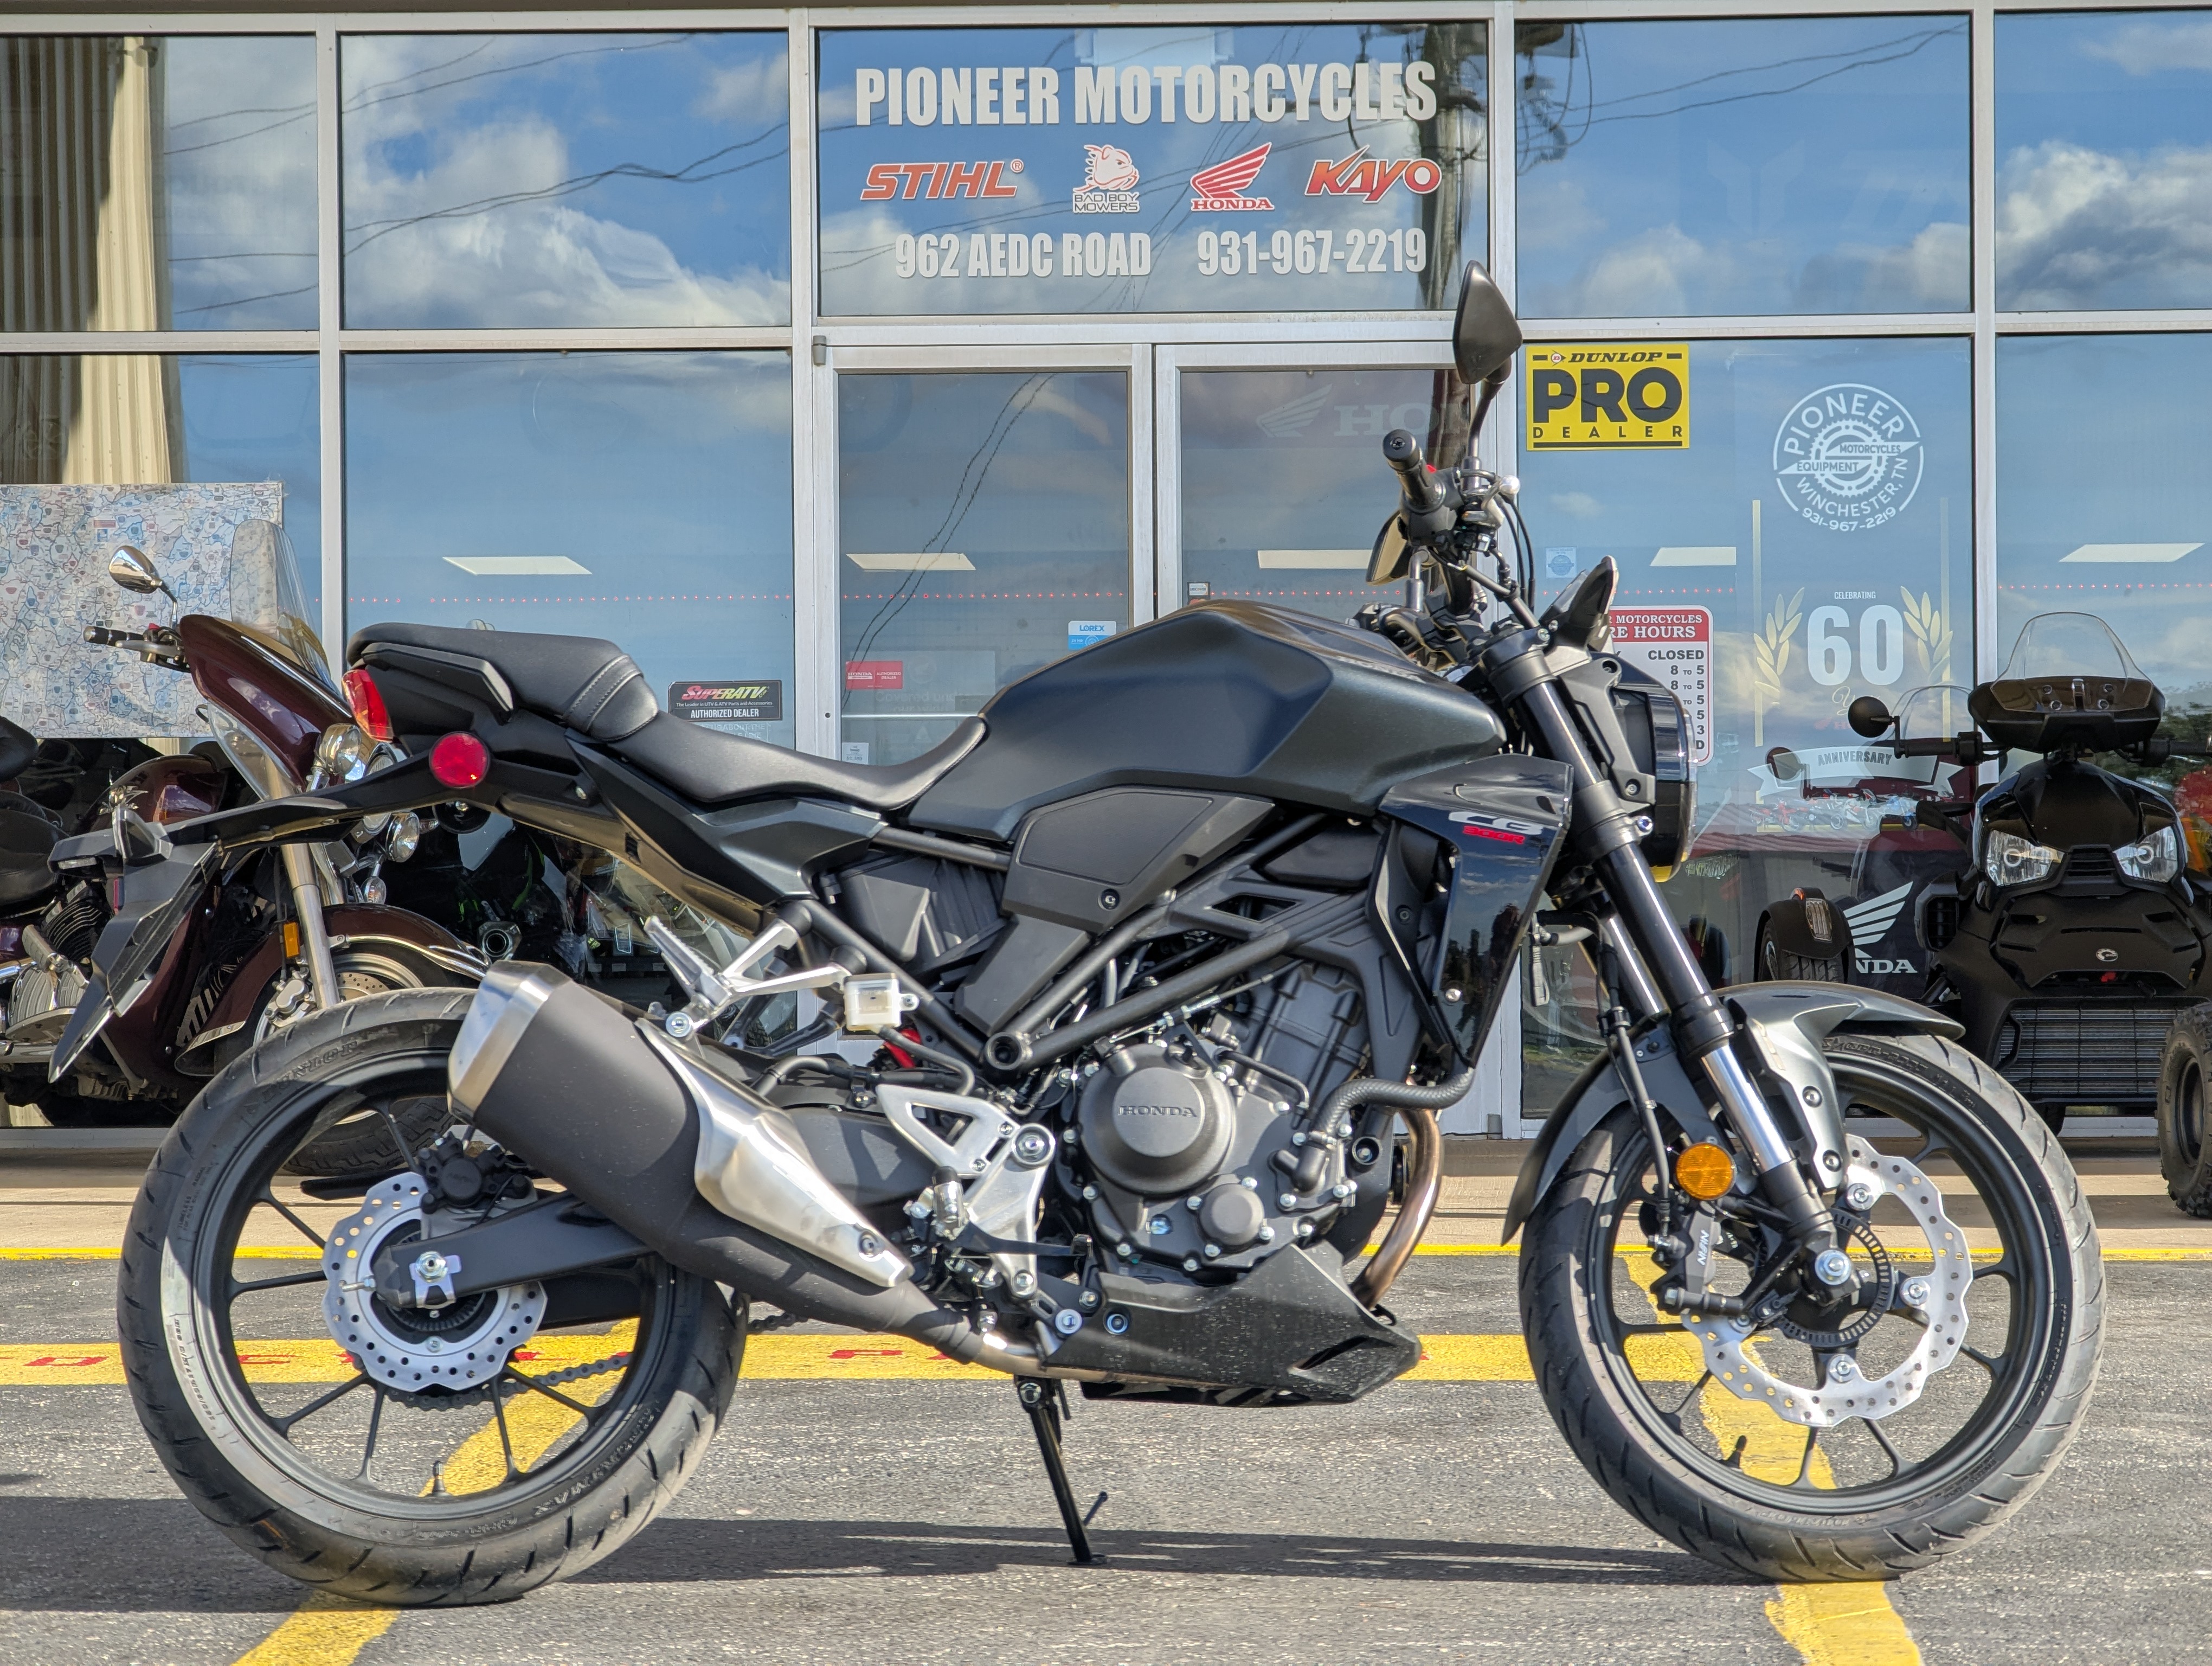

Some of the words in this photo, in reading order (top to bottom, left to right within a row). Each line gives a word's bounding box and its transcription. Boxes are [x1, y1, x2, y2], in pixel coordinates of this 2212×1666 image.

[856, 67, 1059, 126] PIONEER
[1075, 62, 1437, 124] MOTORCYCLES
[1304, 144, 1442, 203] KAYO
[860, 161, 1018, 201] STIHL
[1075, 193, 1105, 202] BAD
[1108, 193, 1139, 202] BOY
[1075, 203, 1139, 211] MOWERS
[1192, 198, 1274, 210] HONDA
[895, 234, 960, 278] 962
[968, 233, 1052, 277] AEDC
[1063, 232, 1151, 276] ROAD
[1198, 228, 1426, 275] 931-967-2219
[1568, 352, 1662, 363] DUNLOP
[1533, 367, 1682, 423] PRO
[1784, 393, 1905, 456] PIONEER
[1533, 426, 1683, 439] DEALER
[1840, 445, 1901, 454] MOTORCYCLES
[1797, 462, 1859, 472] EQUIPMENT
[1891, 458, 1908, 479] TN
[1802, 507, 1896, 531] 931-967-2219
[1834, 591, 1876, 599] CELEBRATING
[1616, 614, 1702, 624] MOTORCYCLES
[1634, 626, 1696, 638] HOURS
[1808, 605, 1904, 685] 60
[1648, 650, 1705, 660] CLOSED
[1670, 665, 1679, 675] 8
[1696, 665, 1705, 675] 5
[1670, 680, 1679, 690] 8
[1696, 680, 1705, 689] 5
[1696, 695, 1705, 705] 5
[691, 709, 732, 718] AUTHORIZED
[734, 708, 759, 717] DEALER
[1696, 710, 1705, 720] 5
[1696, 725, 1705, 735] 3
[1818, 751, 1893, 766] ANNIVERSARY
[1448, 811, 1544, 835] CB
[1462, 825, 1526, 845] 300R
[1856, 959, 1918, 973] NDA
[1118, 1105, 1197, 1117] HONDA
